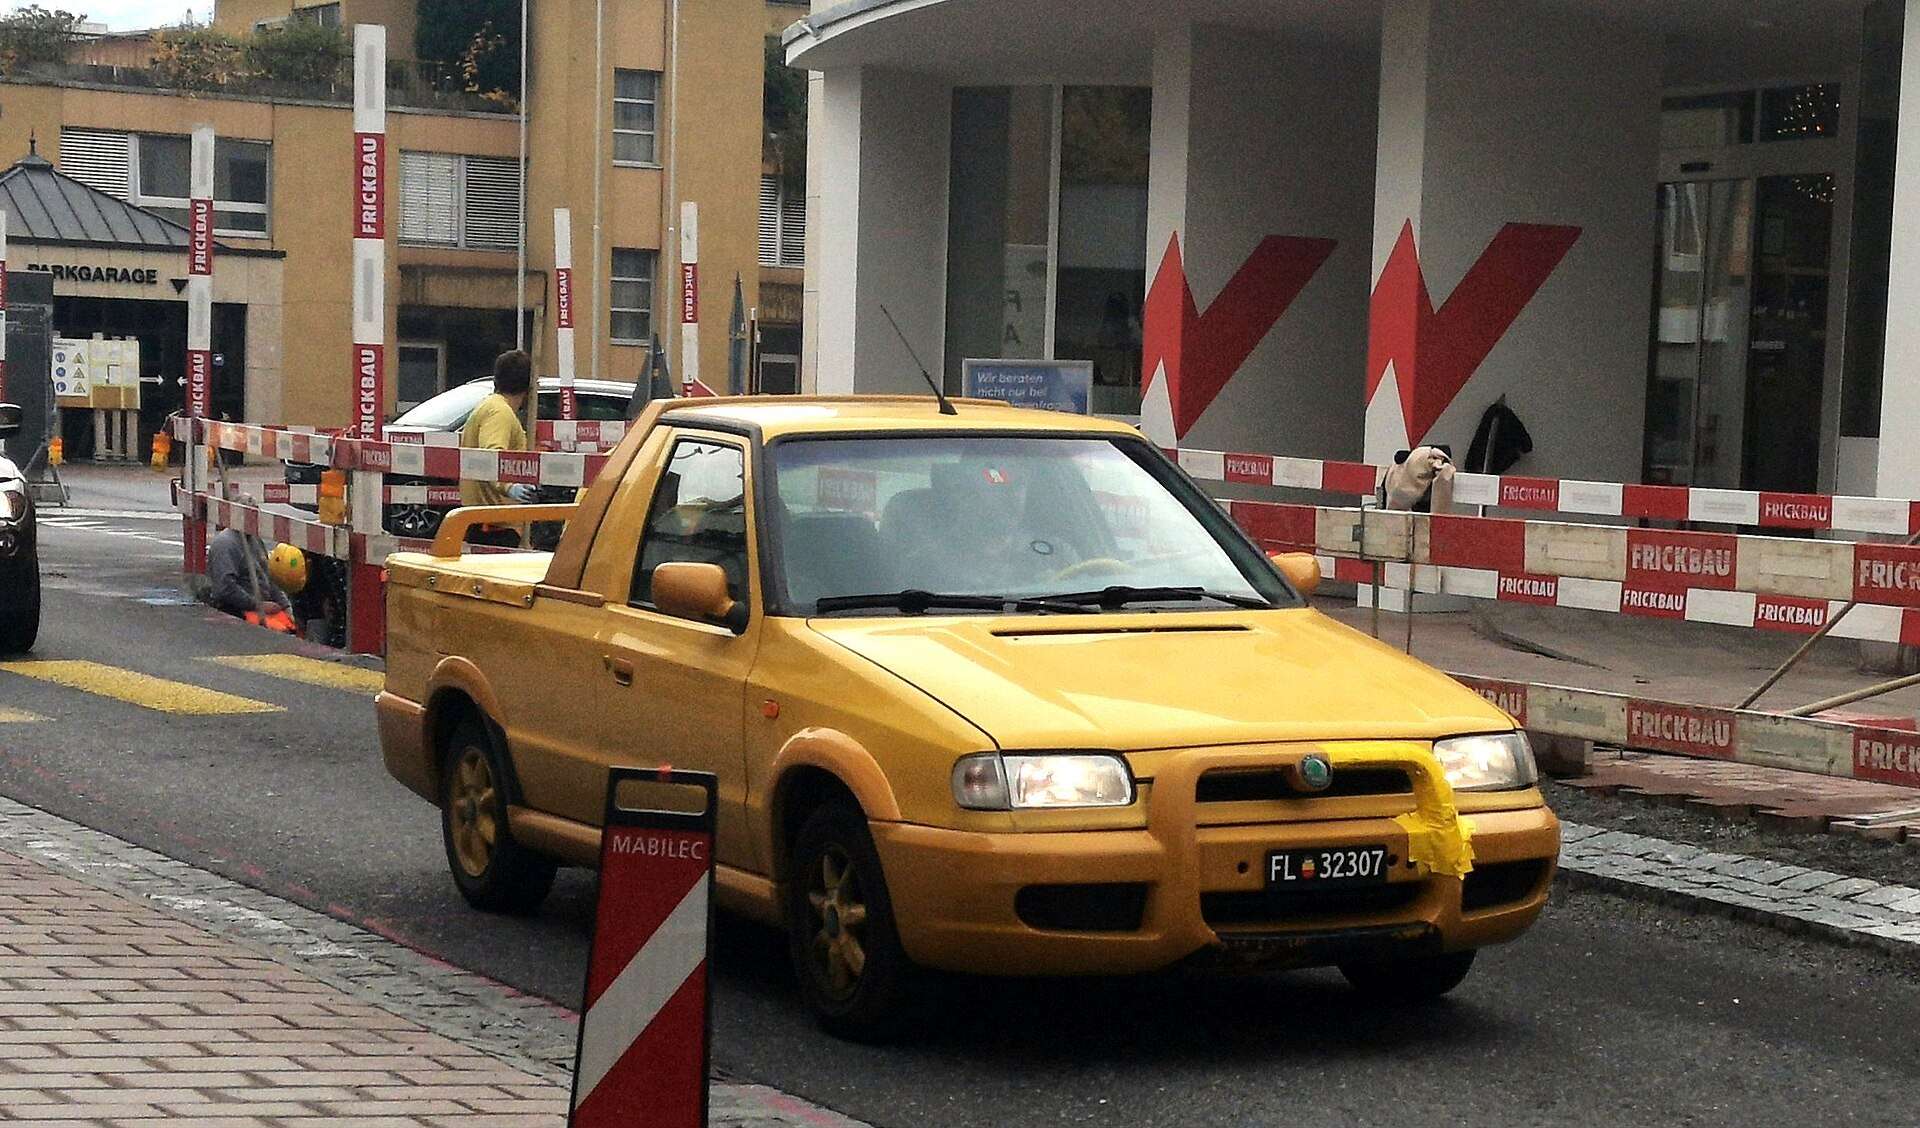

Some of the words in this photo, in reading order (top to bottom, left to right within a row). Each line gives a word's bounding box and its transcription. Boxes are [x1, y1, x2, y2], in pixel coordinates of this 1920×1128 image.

[362, 137, 377, 234] FRICKBAU
[194, 202, 208, 272] FRICKBAU
[559, 271, 569, 326] FRICKBAU
[192, 353, 204, 414] RICKBAU
[977, 371, 997, 384] Wir
[999, 373, 1043, 384] beraten
[500, 458, 539, 478] FRICKBAU
[1226, 459, 1270, 476] FRICKBAU
[1503, 485, 1555, 503] FRICKBAU
[1764, 501, 1828, 522] FRICKBAU
[1631, 543, 1731, 577] FRICKBAU
[1500, 577, 1556, 598] FRICKBAU
[1623, 589, 1685, 612] FRICKBAU
[1757, 603, 1824, 627] FRICKBAU
[1631, 710, 1730, 748] FRICKBAU
[612, 835, 704, 860] MABILEC
[1270, 855, 1296, 881] FL
[1319, 850, 1384, 878] 32307
